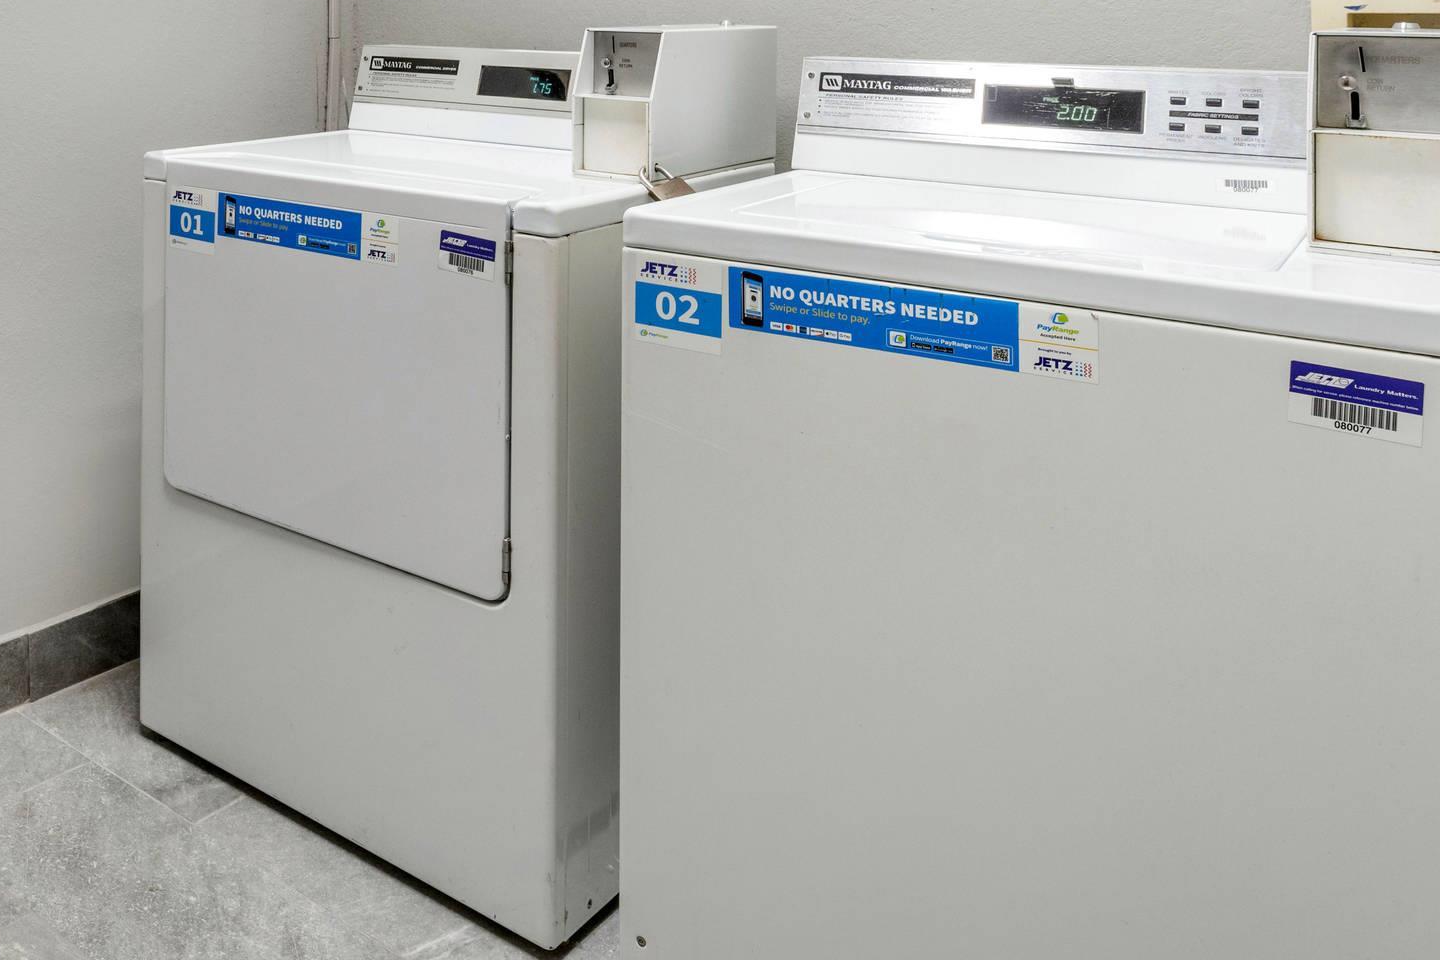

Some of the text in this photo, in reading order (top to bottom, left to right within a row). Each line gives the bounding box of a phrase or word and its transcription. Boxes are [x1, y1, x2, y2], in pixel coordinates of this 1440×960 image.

[383, 61, 412, 69] MAYTAG
[843, 79, 891, 90] MAYTAG
[1057, 105, 1097, 121] 2.00
[174, 191, 193, 200] JETZ
[180, 212, 203, 236] 01
[239, 205, 342, 230] NO QUARTERS NEEDED
[368, 250, 386, 258] JETZ
[641, 261, 678, 277] JETZ
[655, 291, 699, 325] 02
[770, 285, 978, 326] NO QUARTERS NEEDED
[770, 302, 870, 326] Swipe or Slide to pay.
[1037, 324, 1079, 335] PayRange
[910, 334, 939, 344] Download
[940, 340, 972, 349] PayRange
[1034, 356, 1073, 371] JETZ
[1354, 384, 1419, 400] Laundry Matters.
[1334, 420, 1372, 435] 080077
